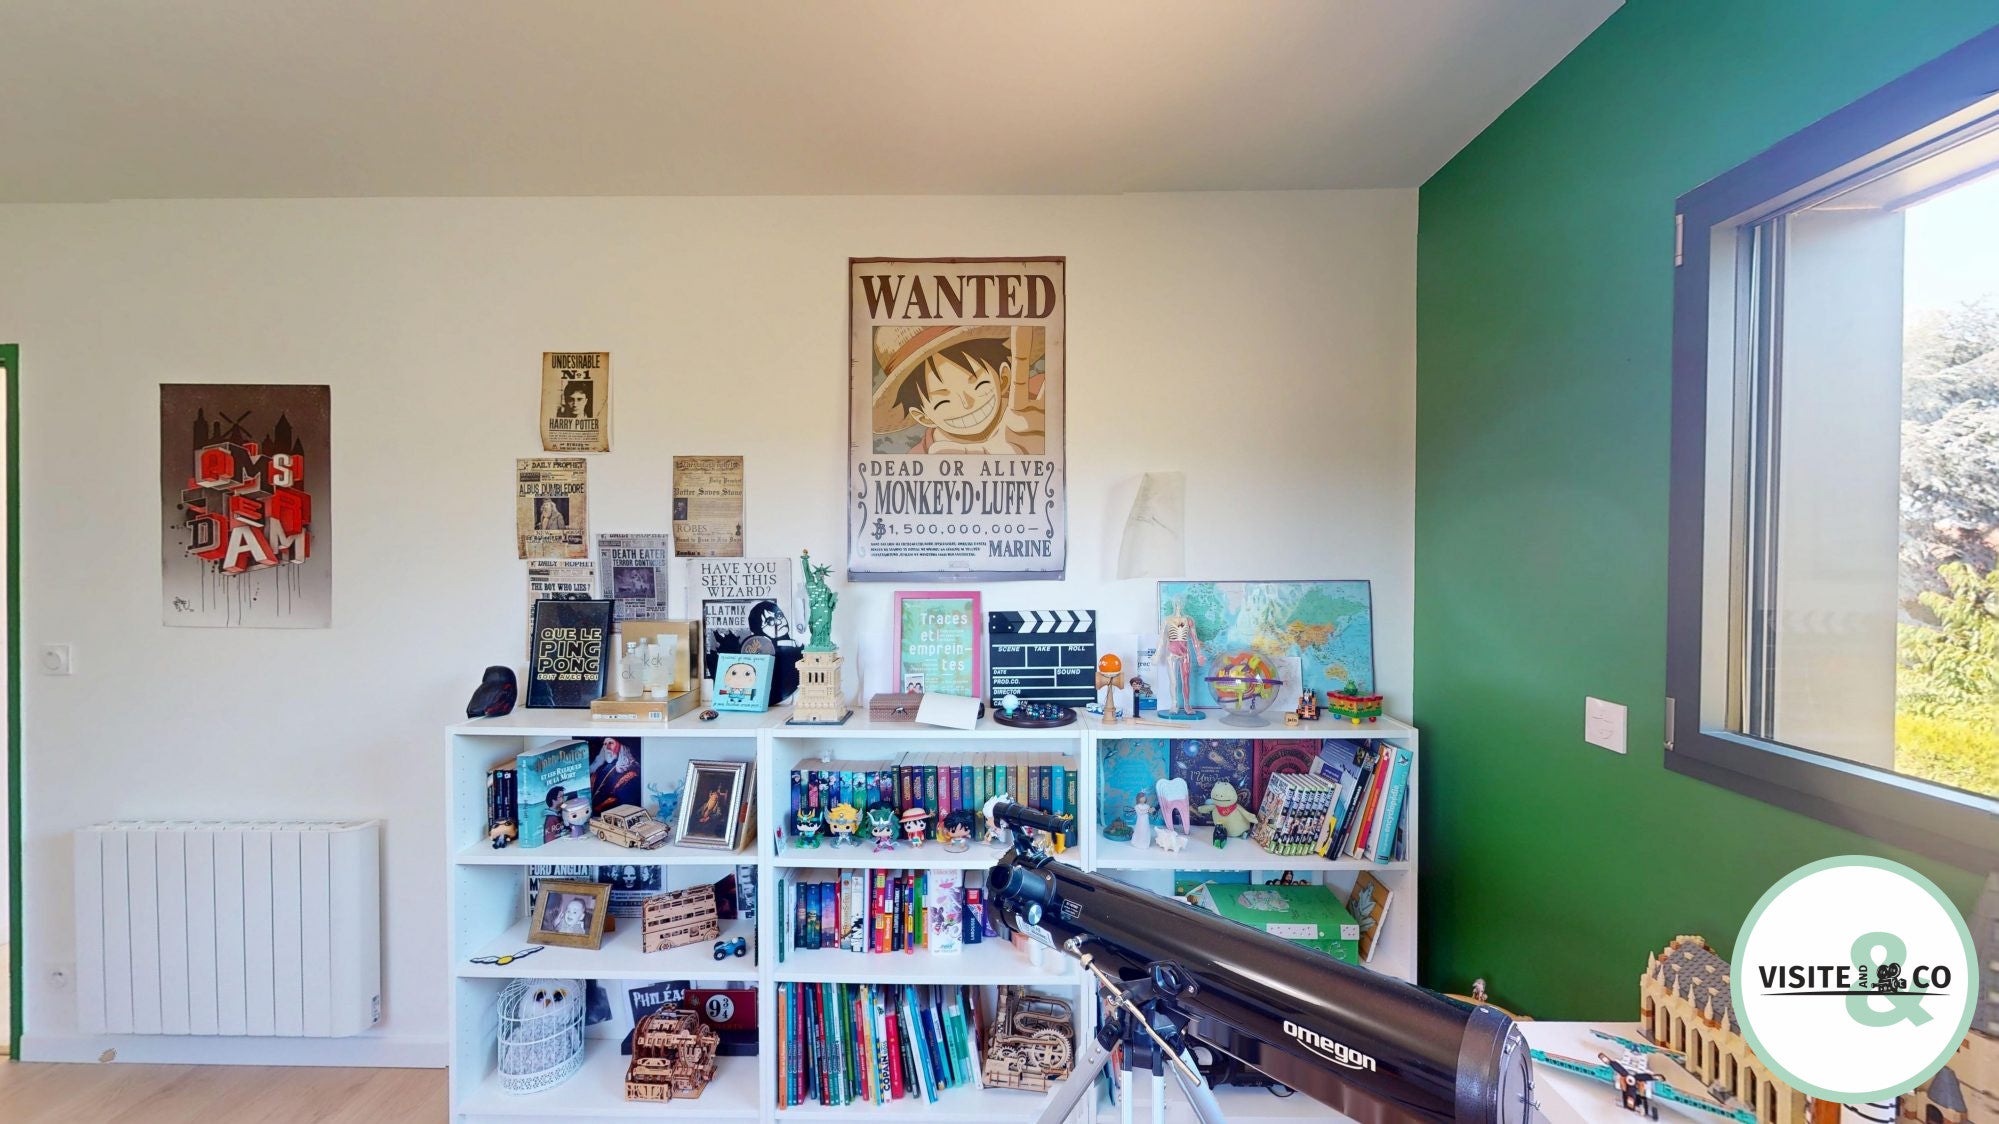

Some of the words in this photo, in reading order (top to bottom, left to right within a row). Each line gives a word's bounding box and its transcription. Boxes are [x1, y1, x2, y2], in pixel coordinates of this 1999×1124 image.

[859, 274, 1056, 319] WANTED
[551, 354, 600, 369] UNDESIRABLE
[549, 418, 573, 430] HARRY
[575, 418, 599, 430] POTTER
[870, 460, 924, 476] DEAD
[939, 460, 965, 476] OR
[979, 460, 1044, 476] ALIVE
[519, 483, 540, 494] ALBUS
[541, 483, 585, 495] DUMBLEDORE
[673, 487, 695, 496] Potter
[697, 487, 720, 496] Saves
[721, 487, 743, 496] Stone
[677, 524, 708, 533] ROBES
[612, 549, 637, 559] DEATH
[640, 549, 665, 559] EATER
[988, 539, 1052, 558] MARINE
[701, 562, 740, 574] HAVE
[744, 562, 776, 574] YOU
[701, 575, 738, 586] SEEN
[742, 574, 777, 586] THIS
[531, 583, 543, 591] THE
[544, 583, 556, 591] BOY
[557, 583, 572, 591] WHO
[707, 586, 771, 597] WIZARD?
[920, 613, 968, 625] Traces
[541, 627, 577, 640] QUE
[581, 628, 602, 641] LE
[920, 630, 935, 642] et
[539, 640, 602, 658] PING
[537, 657, 600, 673] PONG
[651, 653, 662, 667] ck
[942, 659, 965, 671] tes
[537, 673, 557, 681] SOIT
[559, 673, 582, 681] AVEC
[583, 673, 598, 681] TOI
[622, 665, 635, 680] ck
[556, 763, 582, 776] RELIQUES
[560, 772, 577, 782] MORT
[1384, 784, 1400, 833] encyclopédie
[529, 864, 552, 876] FORD
[555, 864, 588, 876] ANGLIA
[1283, 1020, 1376, 1072] omegon
